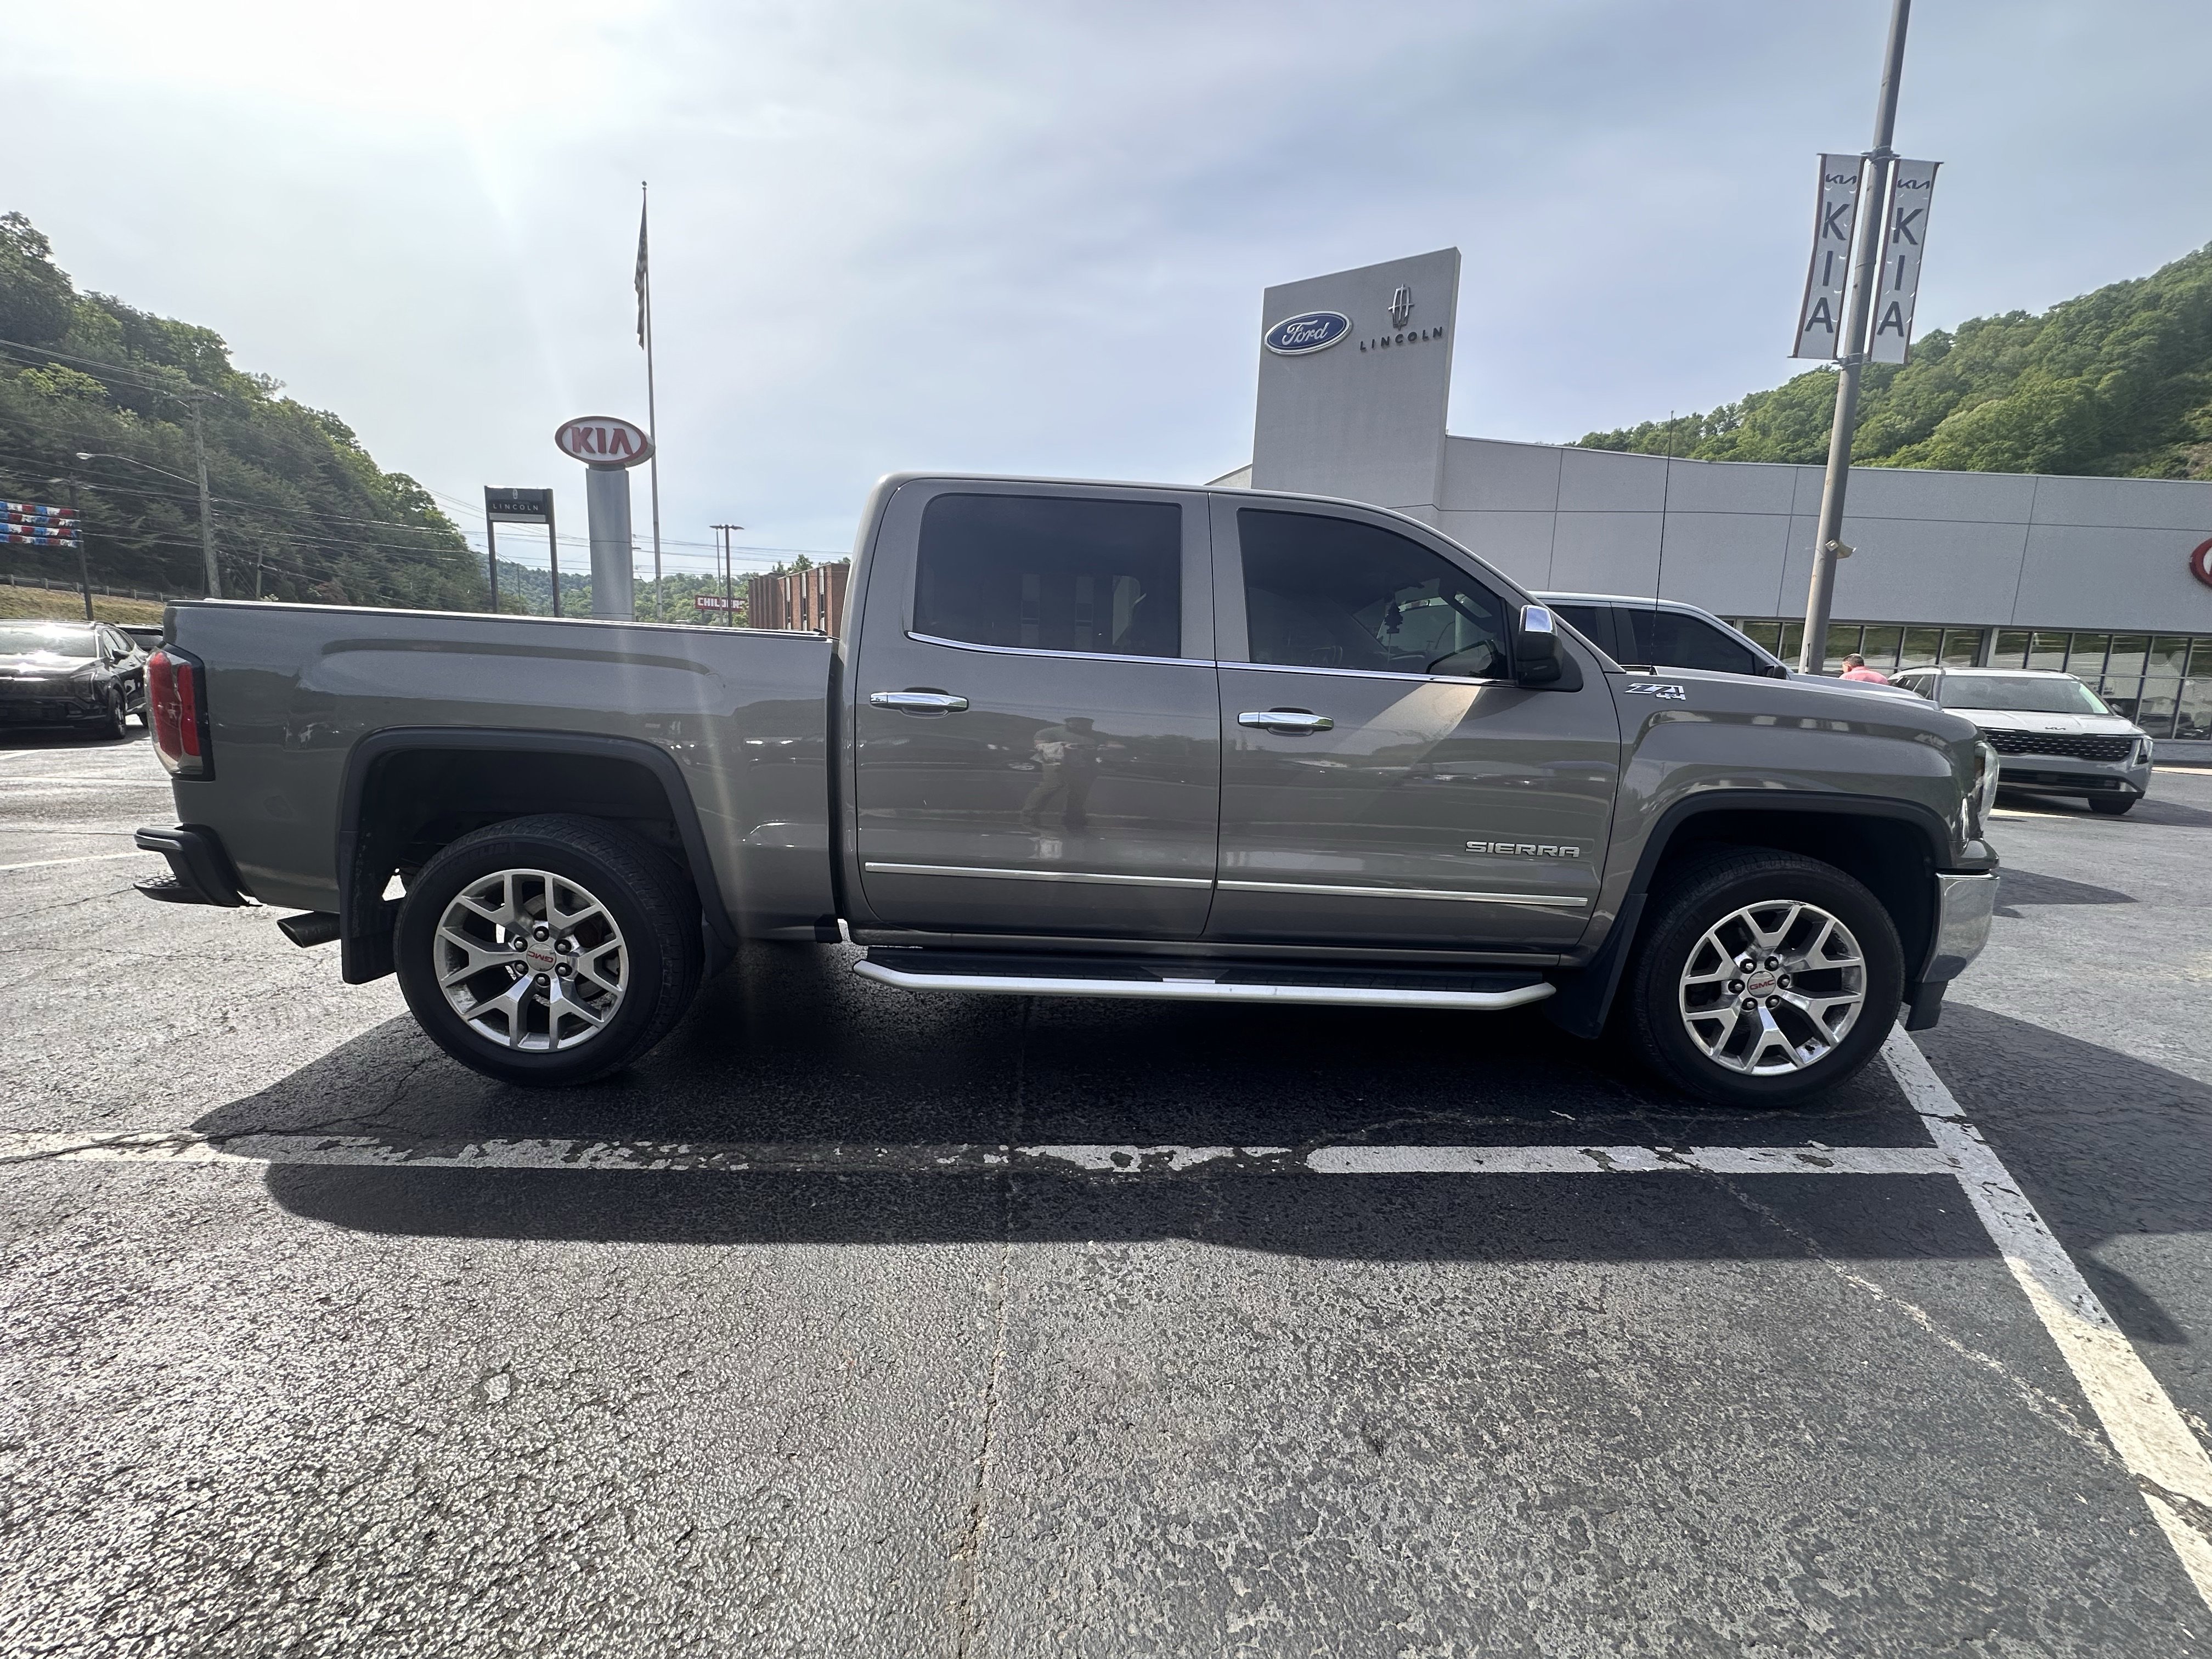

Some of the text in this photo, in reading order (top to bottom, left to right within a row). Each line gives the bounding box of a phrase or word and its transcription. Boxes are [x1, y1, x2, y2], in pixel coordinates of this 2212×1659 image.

[1804, 201, 1850, 333] KIA
[1876, 207, 1923, 337] KIA
[1281, 320, 1330, 346] Ford
[1359, 326, 1443, 352] LINCOLN
[571, 427, 633, 455] KIA
[1624, 683, 1684, 695] Z71
[1465, 841, 1580, 858] SIERRA
[527, 950, 554, 963] GMC
[1750, 979, 1775, 990] GMC
